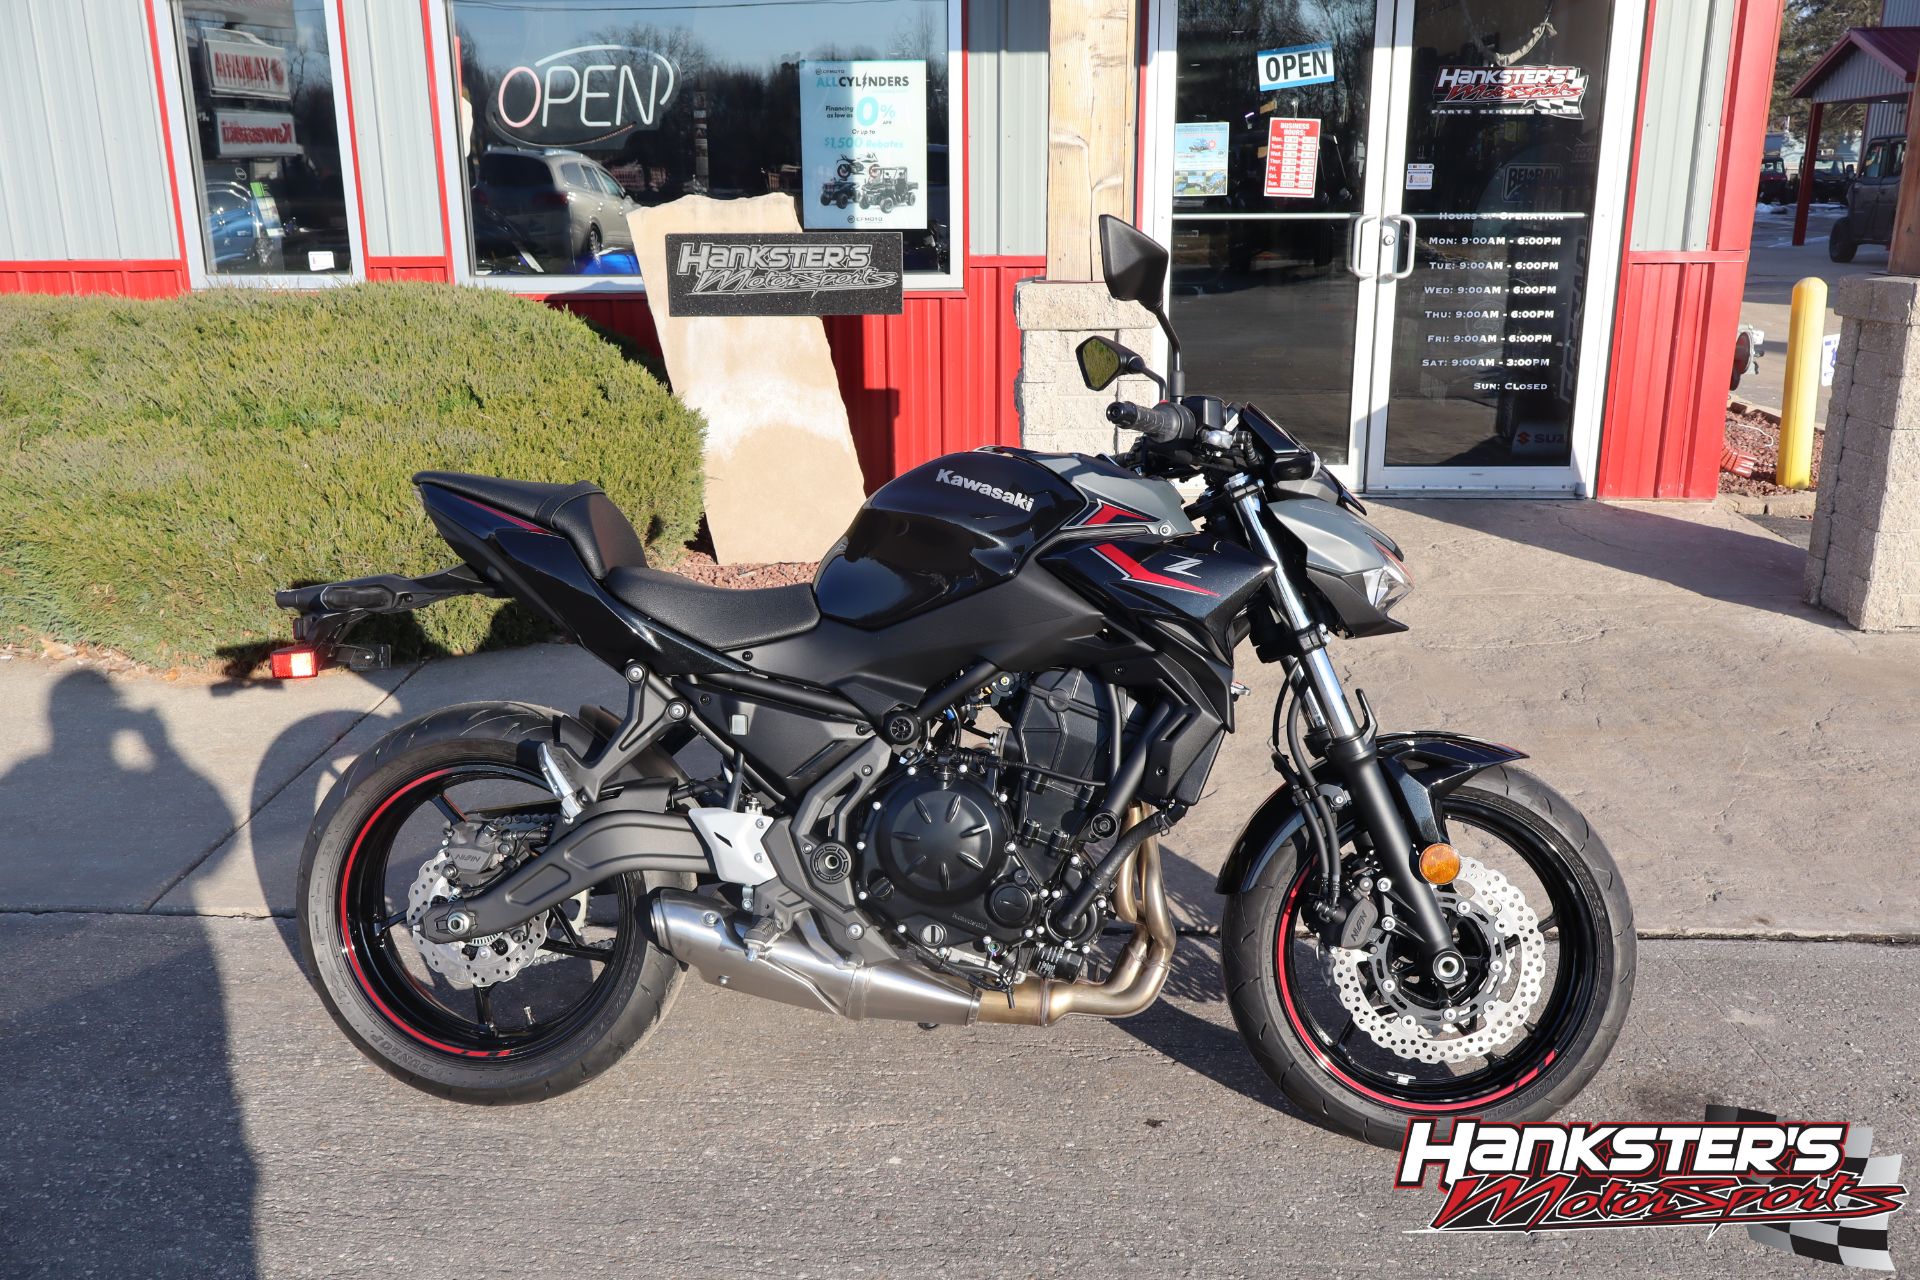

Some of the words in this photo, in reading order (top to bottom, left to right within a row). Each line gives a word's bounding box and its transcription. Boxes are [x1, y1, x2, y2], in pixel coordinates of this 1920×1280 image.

[1265, 50, 1328, 82] OPEN
[497, 65, 659, 128] OPEN
[825, 105, 854, 113] Financing
[1461, 236, 1506, 245] 9:00AM
[1517, 236, 1562, 245] 6:00PM
[1459, 261, 1504, 270] 9:00AM
[1515, 261, 1559, 270] 6:00PM
[1457, 286, 1502, 294] 9:00AM
[1512, 286, 1557, 294] 6:00PM
[1455, 310, 1499, 319] 9:00AM
[1510, 310, 1555, 319] 6:00PM
[1453, 334, 1497, 343] 9:00AM
[1508, 334, 1553, 343] 6:00PM
[1451, 358, 1495, 367] 9:00AM
[1506, 358, 1550, 367] 3:00PM
[1504, 382, 1548, 390] CLOSED
[935, 467, 1035, 513] Kawasaki
